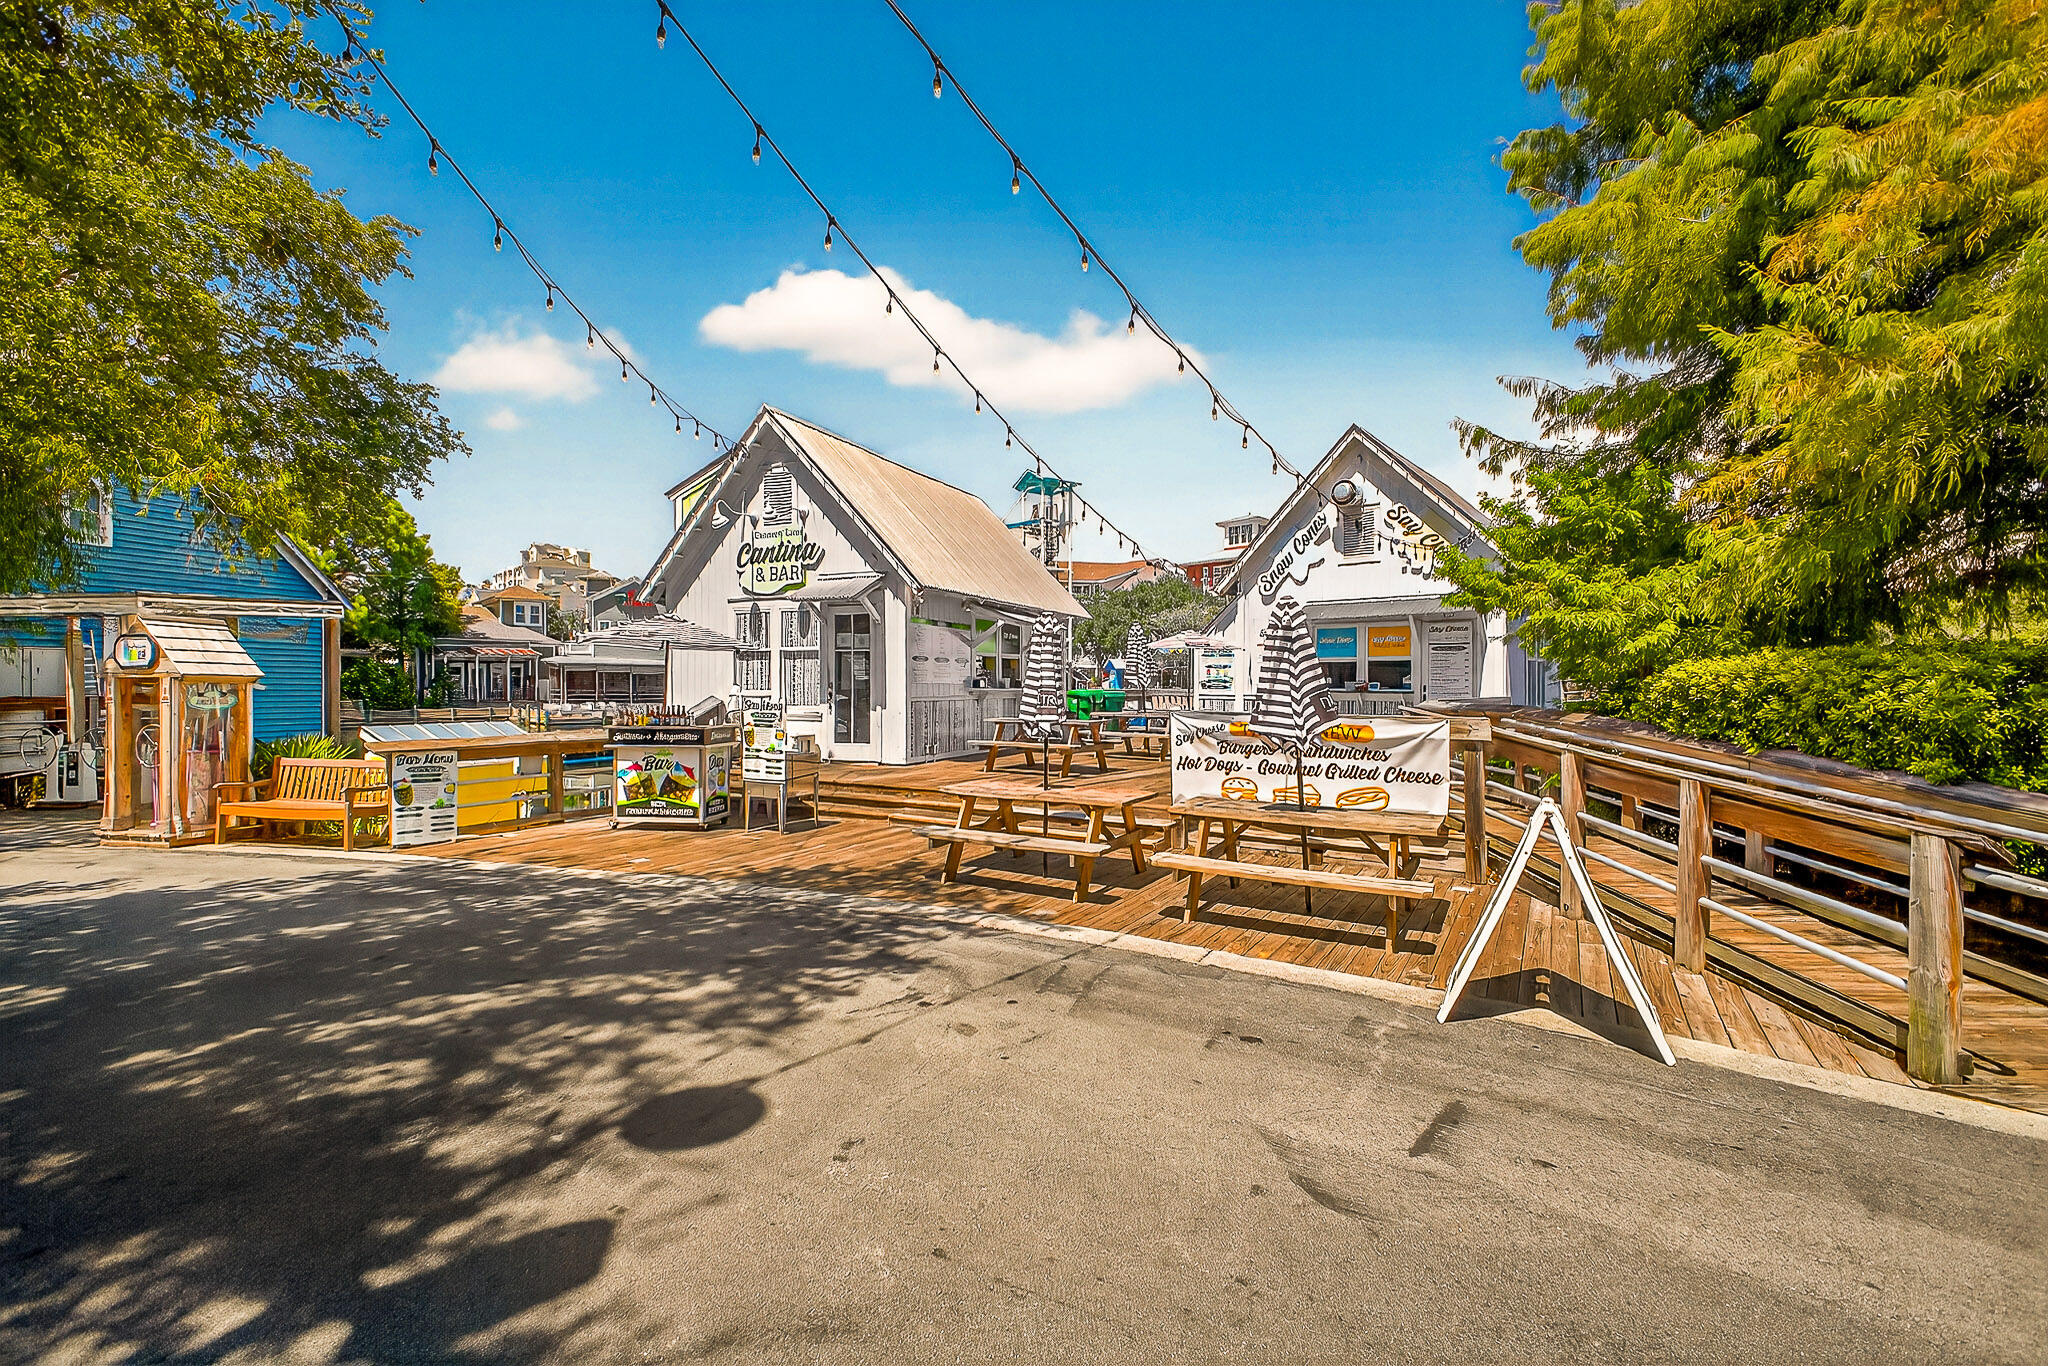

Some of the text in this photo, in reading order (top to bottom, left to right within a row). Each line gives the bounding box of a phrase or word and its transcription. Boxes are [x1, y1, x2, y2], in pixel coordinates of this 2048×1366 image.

[1386, 505, 1423, 536] Say
[736, 540, 821, 568] Cantina
[1260, 512, 1327, 592] Snow Cones
[755, 565, 800, 582] & BAR
[1175, 731, 1195, 746] Say
[1195, 723, 1226, 739] Cheese
[423, 753, 454, 765] Menu
[641, 755, 673, 772] Bar
[1176, 756, 1203, 771] Hot
[1204, 757, 1243, 776] Dogs
[1257, 759, 1323, 777] Gourmet
[1325, 763, 1382, 781] Grilled
[1384, 766, 1445, 785] Cheese
